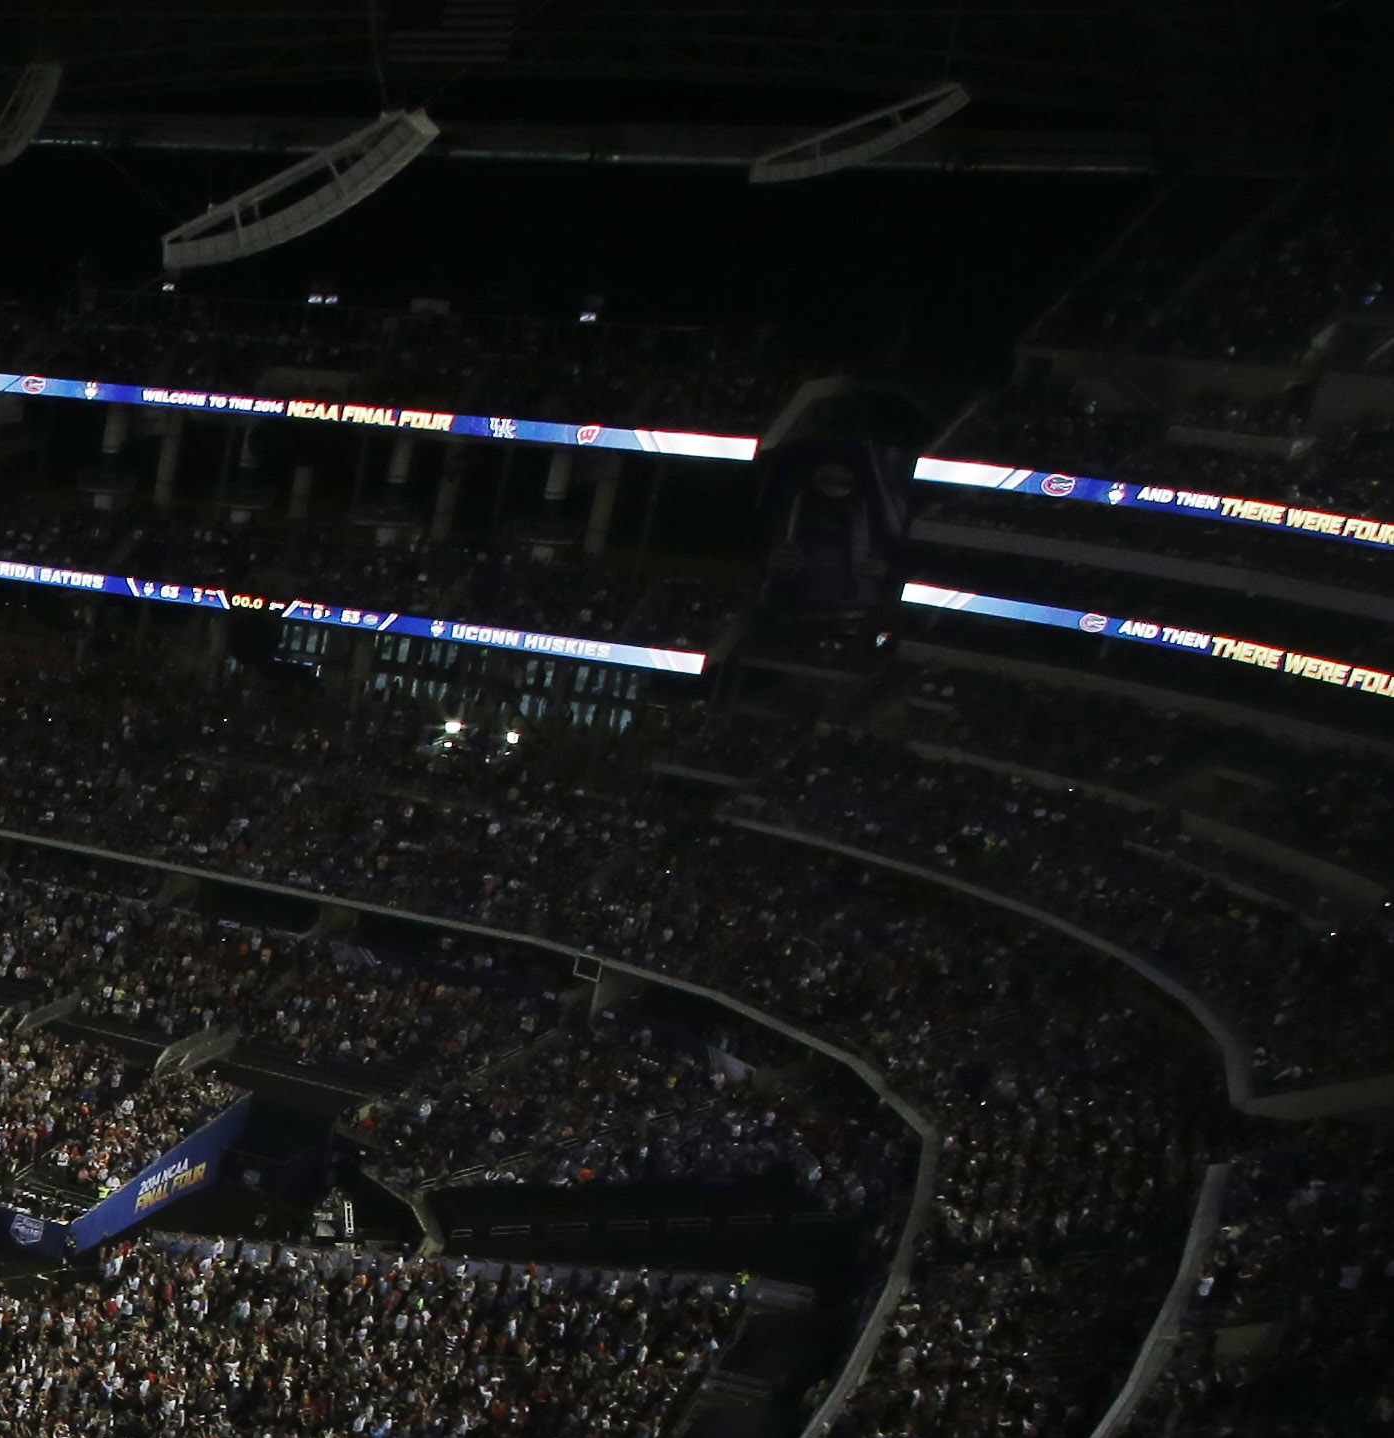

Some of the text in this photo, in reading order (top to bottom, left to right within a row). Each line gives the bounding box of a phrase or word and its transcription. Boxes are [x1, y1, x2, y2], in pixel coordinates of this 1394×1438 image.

[142, 389, 453, 431] WELCOME TO THE 2014 NCAA FINAL FOUR
[1137, 487, 1174, 503] AND
[1176, 492, 1220, 510] THEN
[1220, 498, 1286, 525] THERE
[1285, 508, 1345, 535] WERE
[40, 567, 104, 589] GATORS
[232, 595, 263, 610] 00.0
[341, 610, 360, 624] 53
[452, 624, 612, 658] UCONN HUSKIES
[1119, 621, 1394, 697] AND THEN THERE WERE FOU
[134, 1162, 206, 1214] FINAL FOUR
